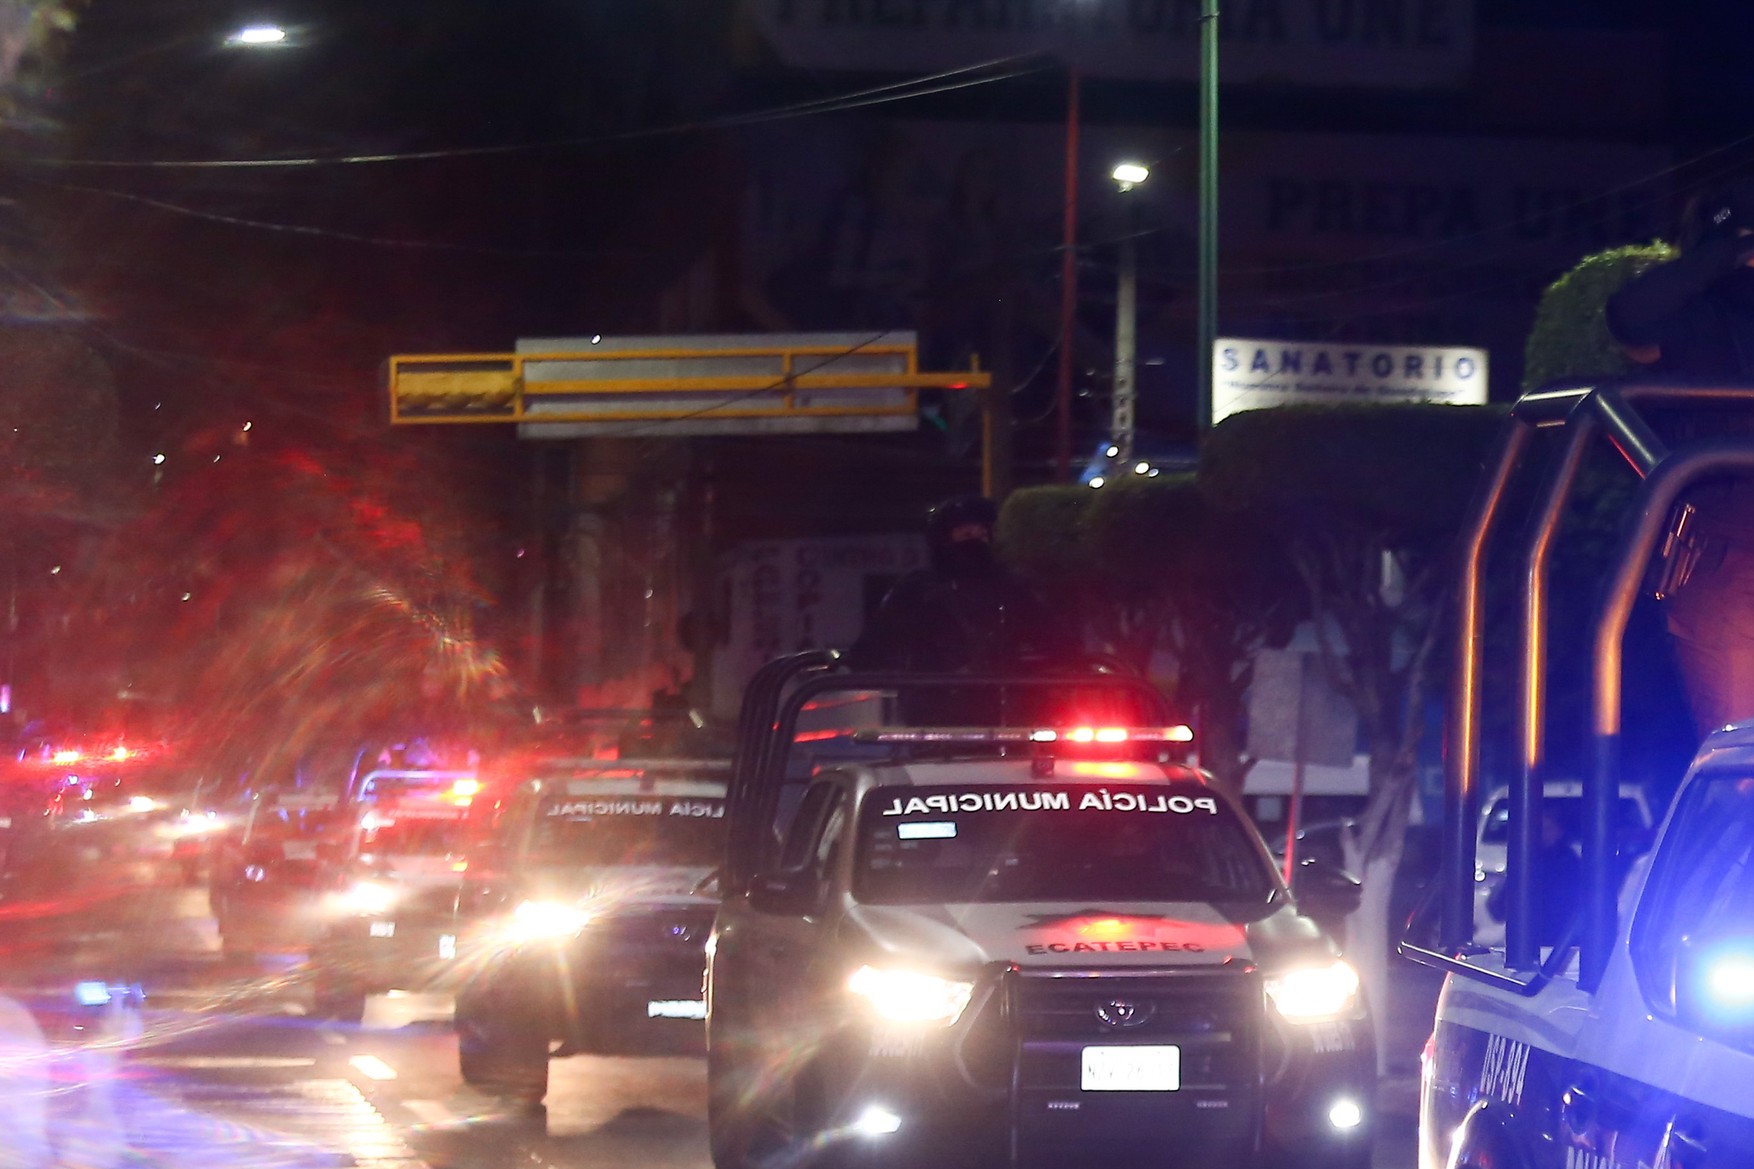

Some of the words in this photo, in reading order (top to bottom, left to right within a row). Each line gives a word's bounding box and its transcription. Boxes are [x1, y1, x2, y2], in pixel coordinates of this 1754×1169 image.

[1221, 347, 1476, 380] SANATORIO
[1024, 941, 1205, 956] ECATEPEC
[1479, 1033, 1531, 1106] DSP-894
